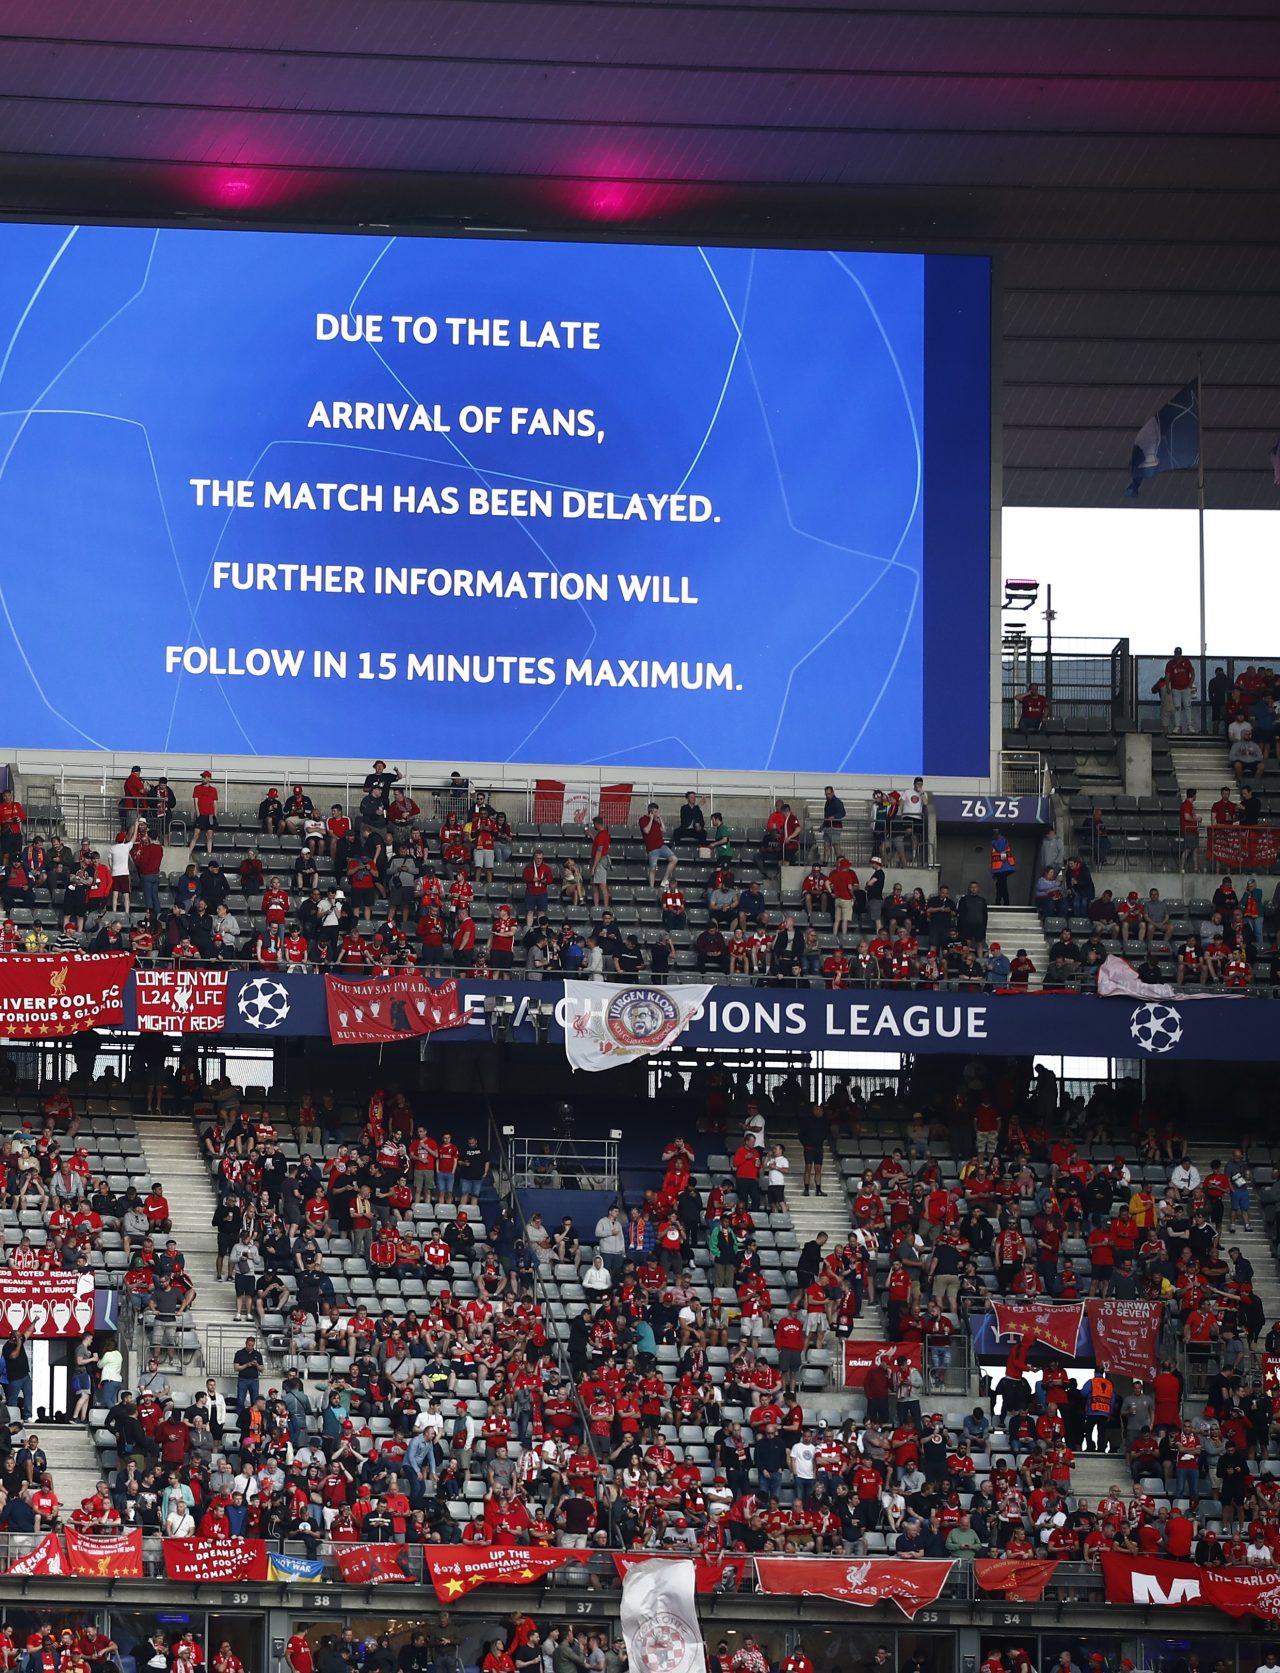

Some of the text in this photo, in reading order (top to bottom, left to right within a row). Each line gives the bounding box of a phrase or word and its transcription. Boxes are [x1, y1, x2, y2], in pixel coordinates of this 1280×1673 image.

[316, 313, 601, 350] DUE TO THE LATE
[307, 401, 605, 444] ARRIVAL OF FANS,
[189, 478, 721, 523] THE MATCH HAS BEEN DELAYED.
[213, 561, 699, 604] FURTHER INFORMATION WILL
[165, 645, 743, 691] FOLLOW IN 15 MINUTES MAXIMUM.
[961, 800, 1019, 819] Z6 Z5
[136, 971, 229, 986] COME ON YOU
[101, 985, 119, 1001] FC
[331, 981, 416, 996] YOU MAY SAY I'M A
[142, 990, 222, 1005] L24 LFC
[647, 992, 675, 1020] KLOPP
[62, 1010, 71, 1020] &
[826, 1003, 988, 1038] LEAGUE
[138, 1015, 225, 1031] MIGHTY REDS
[337, 1031, 356, 1039] BUT
[1104, 1301, 1157, 1310] STAIRWAY
[1116, 1308, 1150, 1318] SEVEN
[196, 1547, 242, 1560] DREAMER
[489, 1550, 530, 1560] UP THE
[184, 1564, 198, 1572] AM
[292, 1563, 311, 1572] WAR
[465, 1560, 520, 1572] BOREHAM
[233, 1594, 249, 1603] 39
[314, 1596, 330, 1606] 38
[577, 1603, 592, 1613] 37
[923, 1612, 938, 1622] 35
[1004, 1614, 1019, 1624] 34
